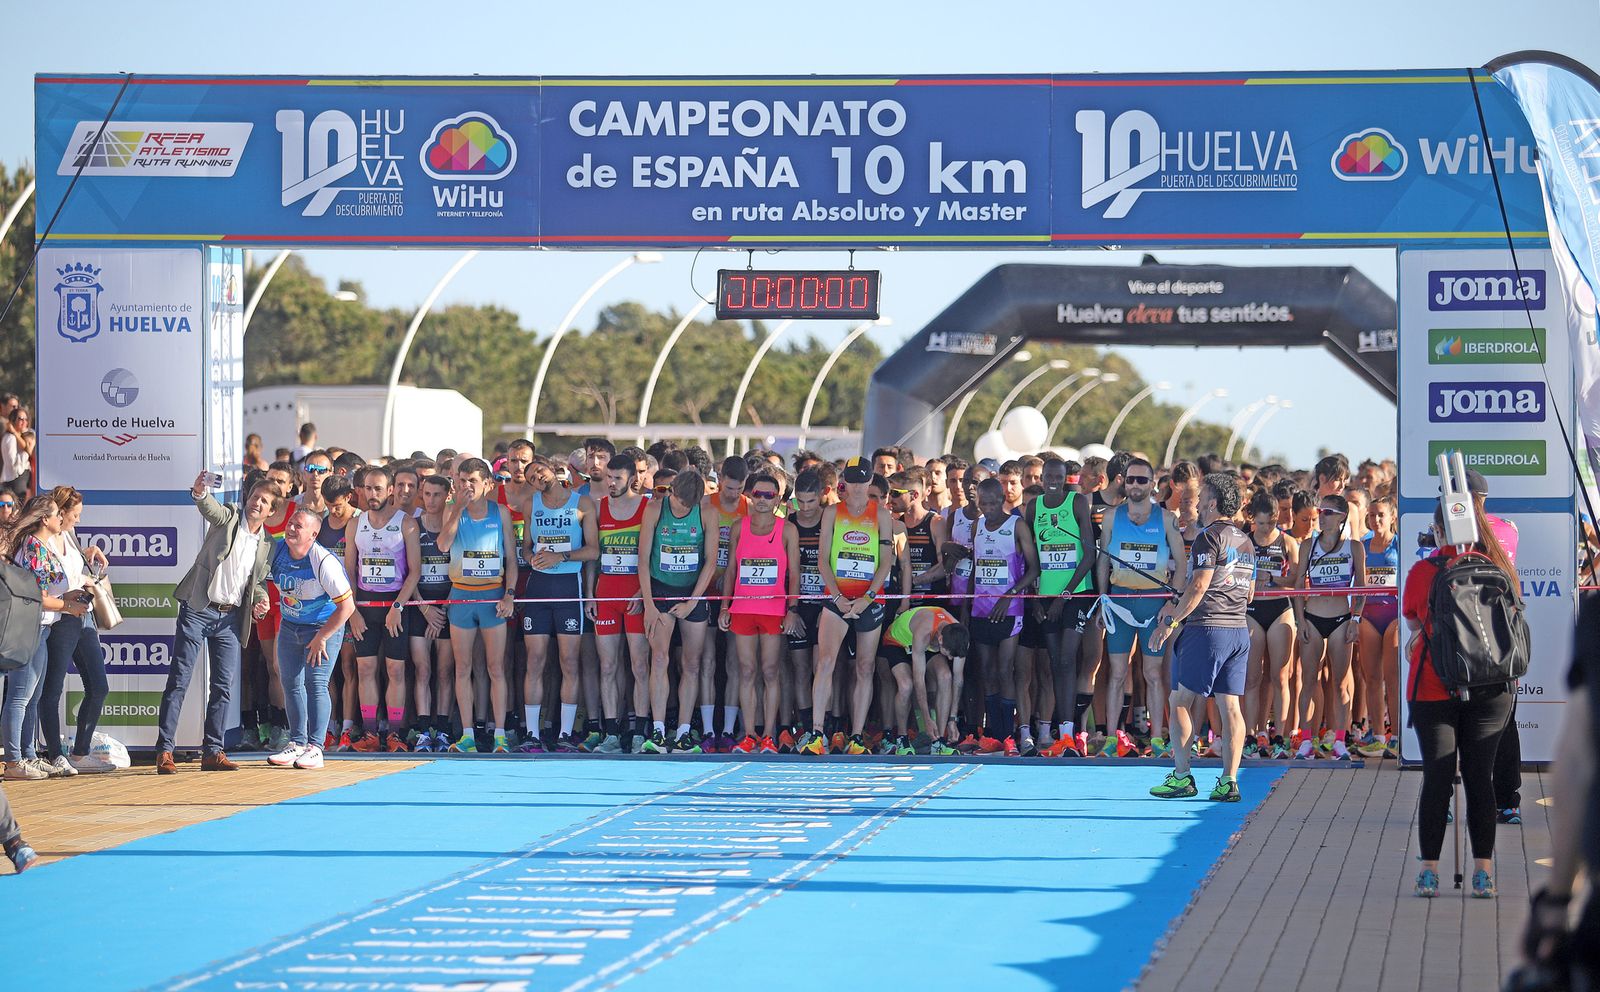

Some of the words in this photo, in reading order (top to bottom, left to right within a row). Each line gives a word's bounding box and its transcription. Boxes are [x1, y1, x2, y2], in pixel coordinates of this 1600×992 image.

[569, 100, 907, 137] CAMPEONATO
[144, 132, 206, 146] RFEA
[139, 147, 231, 156] ATLETISMO
[1161, 130, 1298, 172] HUELVA
[133, 158, 171, 168] RUTA
[174, 159, 234, 168] RUNNING
[566, 153, 617, 189] de
[632, 147, 799, 189] ESPAÑA
[831, 143, 905, 196] 10
[929, 141, 1027, 194] km
[1160, 174, 1195, 188] PUERTA
[1197, 174, 1214, 188] DEL
[1216, 173, 1298, 188] DESCUBRIMIENTO
[358, 192, 387, 205] PUERTA
[389, 192, 403, 205] DEL
[432, 184, 504, 208] WiHu
[335, 204, 404, 217] DESCUBRIMIENTO
[691, 205, 723, 222] en
[731, 203, 784, 222] ruta
[791, 199, 905, 222] Absoluto
[913, 205, 931, 226] y
[937, 201, 1027, 222] Master
[1128, 279, 1157, 295] Vive
[1157, 279, 1170, 294] el
[1171, 280, 1225, 296] deporte
[110, 303, 177, 314] Ayuntamiento
[180, 303, 192, 313] de
[1057, 303, 1124, 324] Huelva
[1177, 304, 1209, 323] tus
[109, 316, 192, 333] HUELVA
[1464, 342, 1539, 354] IBERDROLA
[66, 417, 108, 428] Puerto
[112, 417, 127, 428] de
[131, 417, 175, 428] Huelva
[73, 453, 105, 462] Autoridad
[106, 453, 137, 462] Portuaria
[138, 453, 147, 462] de
[147, 453, 171, 462] Huelva
[1465, 454, 1539, 465] IBERDROLA
[536, 515, 571, 528] nerja
[616, 556, 622, 565] 3
[672, 555, 686, 564] 14
[1048, 552, 1067, 562] 107
[1134, 552, 1142, 562] 9
[478, 560, 485, 569] 8
[852, 562, 859, 570] 2
[370, 566, 382, 576] 12
[430, 566, 437, 574] 4
[752, 568, 765, 576] 27
[981, 568, 998, 577] 187
[1320, 566, 1340, 576] 409
[1549, 566, 1562, 576] de
[802, 575, 820, 584] 152
[1368, 576, 1386, 585] 426
